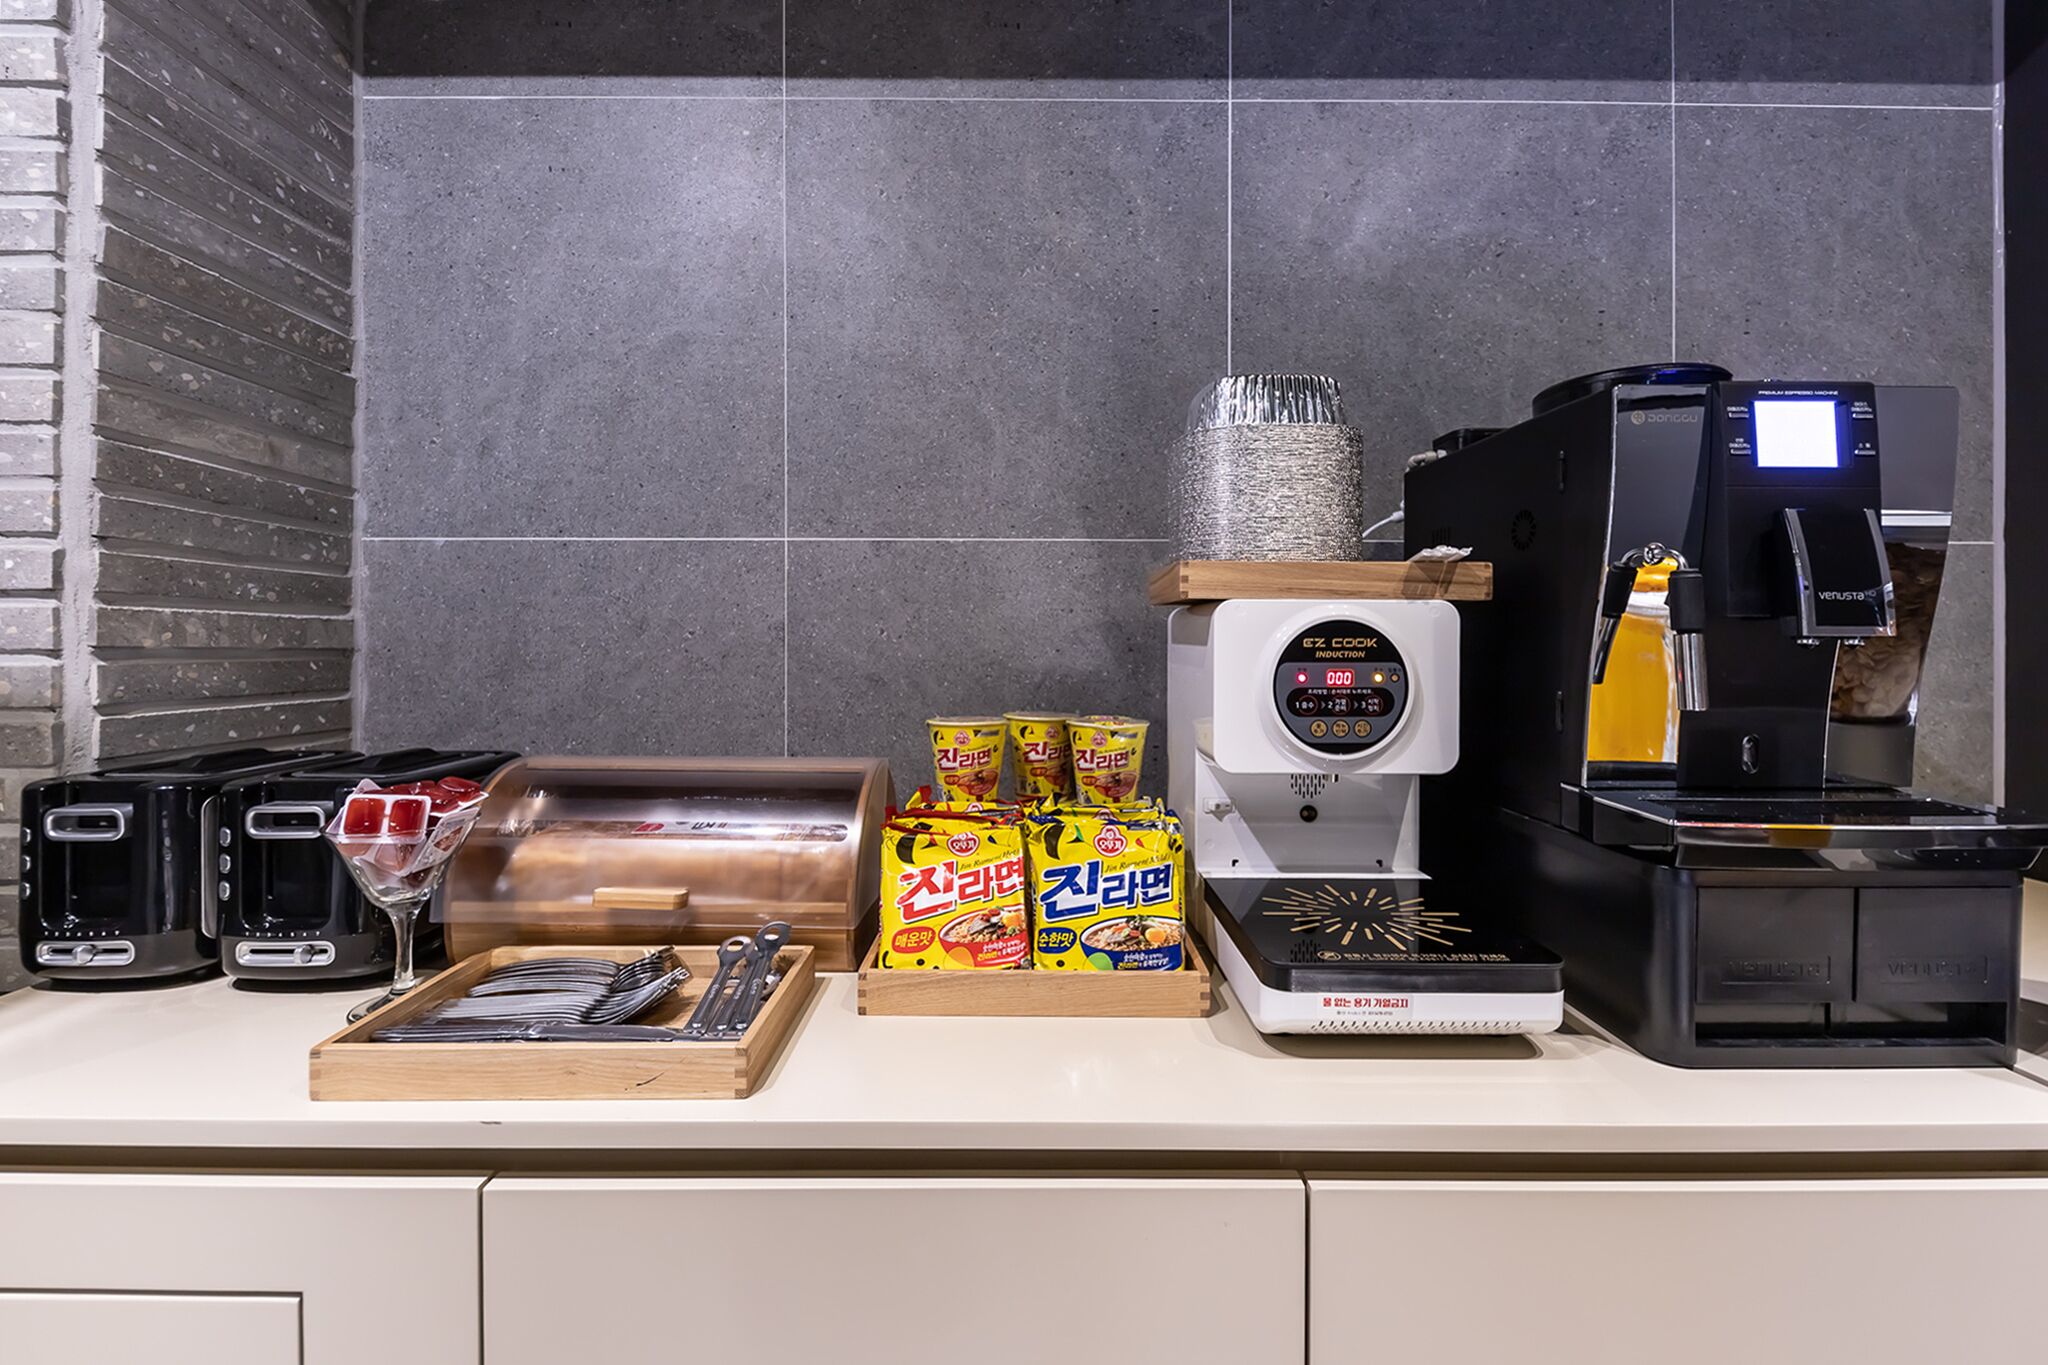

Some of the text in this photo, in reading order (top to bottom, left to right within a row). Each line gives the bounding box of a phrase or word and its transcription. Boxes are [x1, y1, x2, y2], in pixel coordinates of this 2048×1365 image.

[1303, 637, 1378, 648] EZ COOK
[1315, 650, 1366, 658] INDUCTION
[1327, 671, 1352, 685] 000
[937, 747, 992, 771] 진라면
[1075, 748, 1129, 772] 진라면
[897, 856, 1024, 921] 진라면
[1039, 859, 1172, 920] 진라면
[895, 930, 933, 947] 매운맛
[1038, 930, 1074, 947] 순한맛
[1323, 997, 1409, 1008] 물 없는 용기 가열금지
